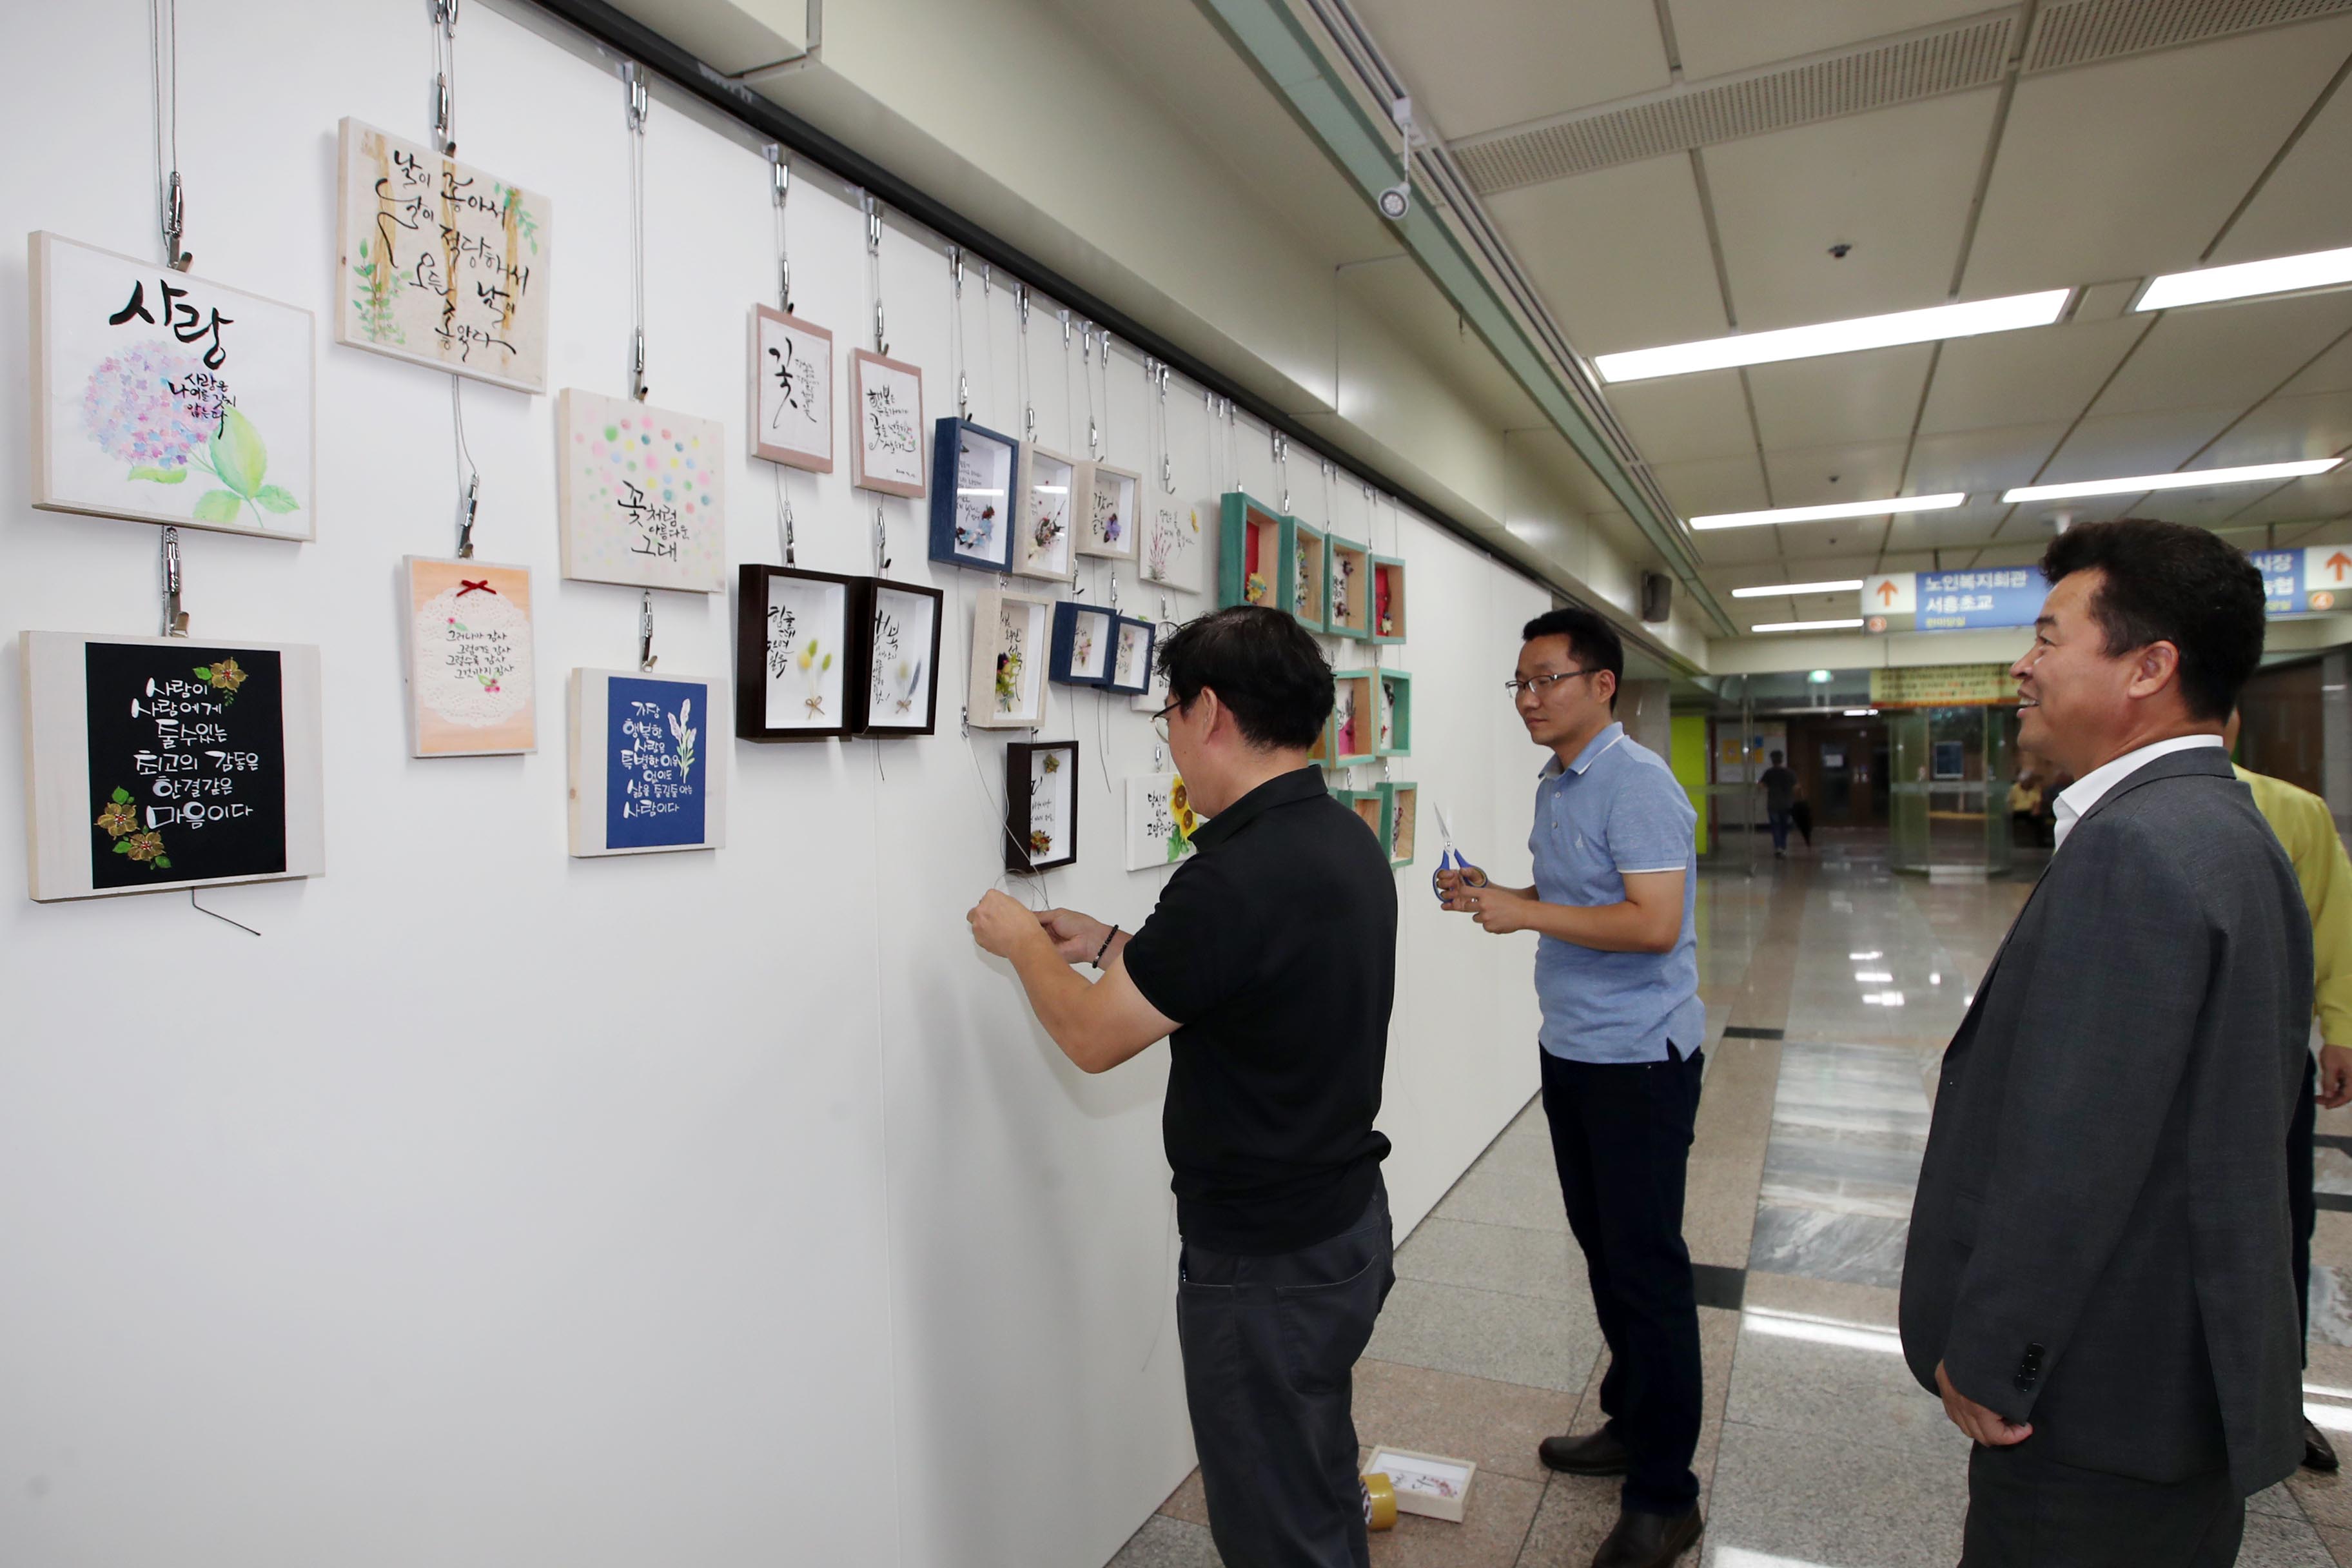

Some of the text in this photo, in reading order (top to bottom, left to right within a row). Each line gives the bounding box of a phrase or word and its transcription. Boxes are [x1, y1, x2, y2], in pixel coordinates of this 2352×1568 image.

[394, 149, 507, 231] 날이 좋아서
[477, 281, 515, 328] 날이
[108, 279, 235, 371] 사랑
[435, 298, 516, 362] 좋았다
[168, 380, 208, 402] 나이를
[184, 373, 229, 393] 사랑은
[768, 336, 798, 429] 꽃
[187, 402, 228, 440] 않는다
[618, 480, 678, 528] 꽃처럼
[649, 524, 690, 540] 아름다운
[631, 534, 677, 562] 그대
[1925, 570, 2028, 592] 노인복지회관
[487, 629, 507, 642] 감사
[485, 654, 506, 665] 감사
[493, 645, 511, 656] 감사
[494, 665, 514, 676] 감사
[146, 677, 208, 699] 사람이
[131, 698, 222, 718] 사람에게
[631, 701, 660, 719] 가장
[622, 718, 663, 739] 행복한
[133, 750, 259, 775] 최고의 감동은
[620, 749, 679, 770] 특별한 이유
[152, 776, 233, 799] 한결같은
[643, 770, 672, 784] 없이도
[627, 779, 650, 799] 삶을
[679, 785, 693, 795] 아는
[146, 801, 254, 829] 마음이다
[623, 799, 680, 819] 사람이다
